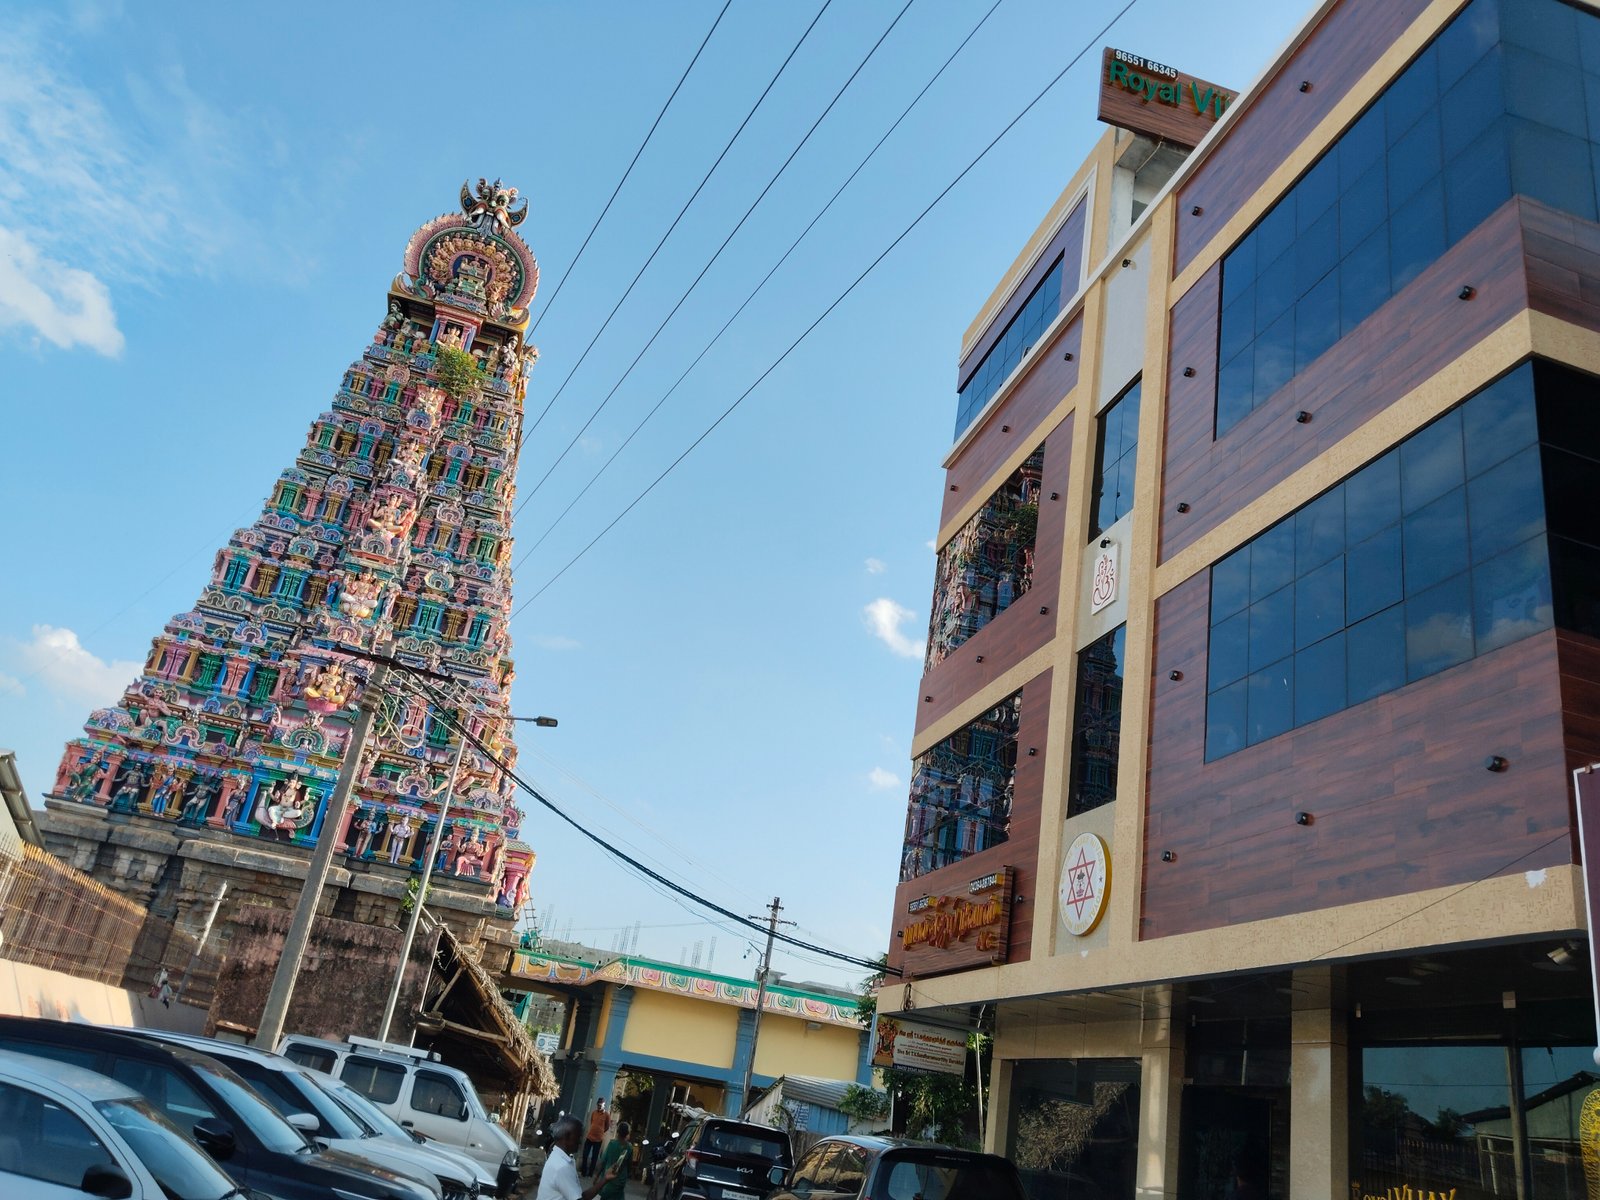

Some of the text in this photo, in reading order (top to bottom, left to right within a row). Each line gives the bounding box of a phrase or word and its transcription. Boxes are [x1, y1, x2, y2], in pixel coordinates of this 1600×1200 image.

[1115, 50, 1177, 79] 96551 66345
[1109, 59, 1182, 106] Royal
[736, 1166, 754, 1174] KIA
